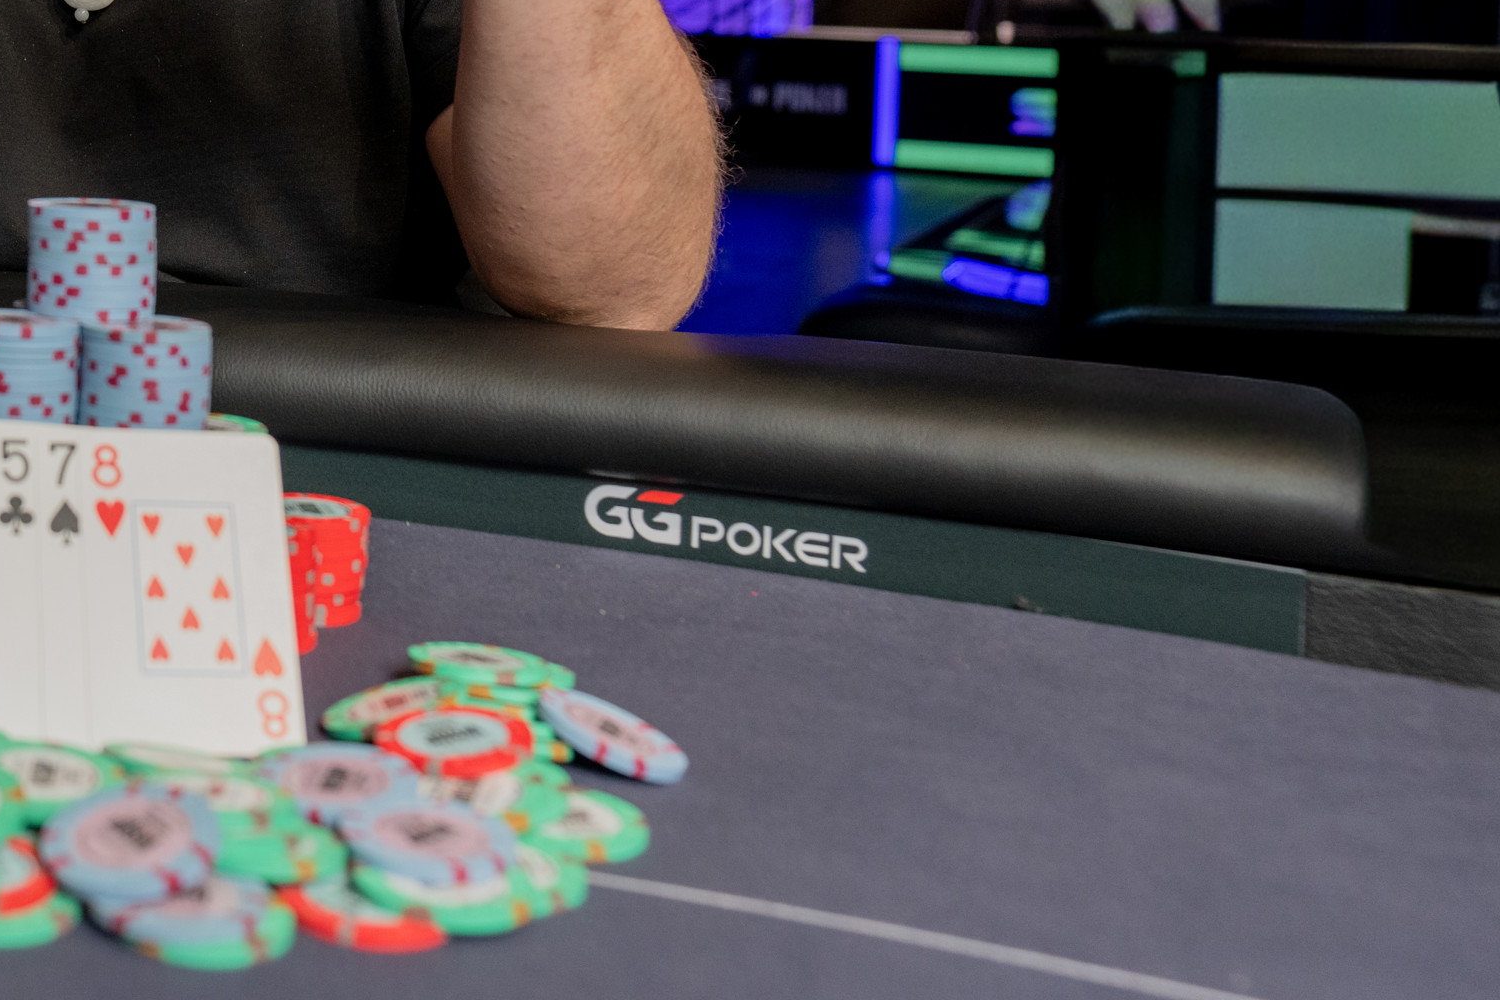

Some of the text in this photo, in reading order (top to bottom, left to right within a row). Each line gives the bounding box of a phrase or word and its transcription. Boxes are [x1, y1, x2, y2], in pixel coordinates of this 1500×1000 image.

[1, 438, 32, 483] 5
[49, 442, 78, 486] 7
[90, 444, 123, 488] 8
[256, 689, 289, 738] 8
